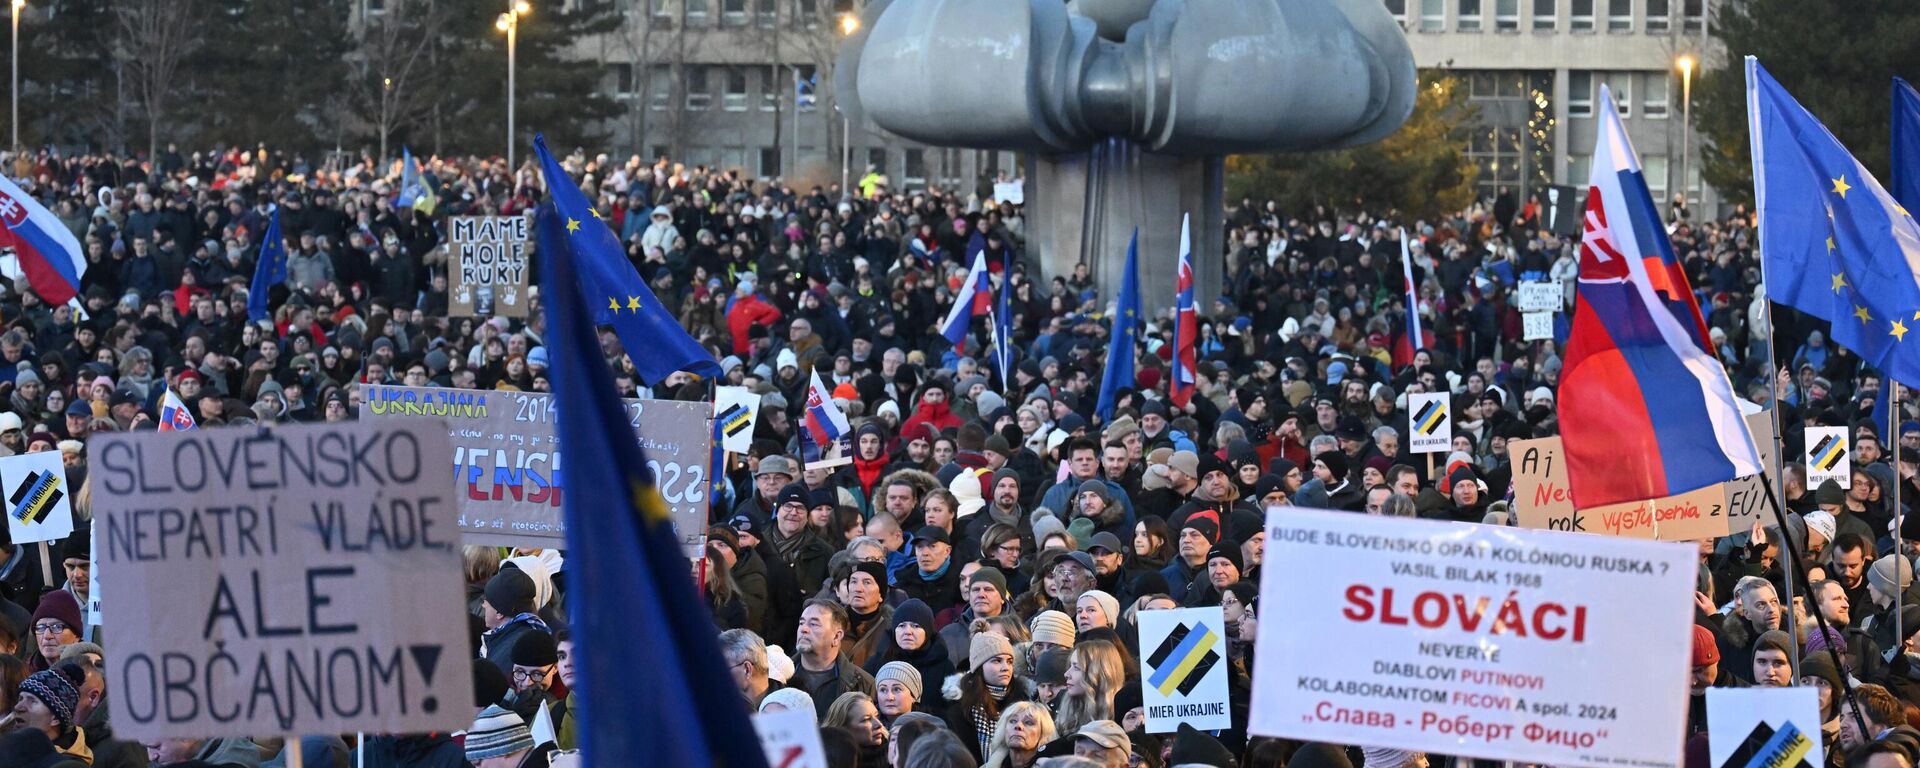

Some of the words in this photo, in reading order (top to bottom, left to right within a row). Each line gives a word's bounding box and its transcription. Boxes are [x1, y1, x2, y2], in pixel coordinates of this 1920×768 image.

[462, 264, 524, 285] RUKY
[368, 387, 488, 418] UKRAJINA
[17, 501, 34, 522] MIER
[32, 474, 57, 508] UKRAJINE
[107, 497, 277, 562] NEPATRÍ
[1549, 509, 1585, 532] rok
[1271, 526, 1319, 545] BUDE
[1325, 531, 1432, 555] SLOVENSKO
[1491, 545, 1586, 569] KOLÓNIOU
[1591, 555, 1654, 574] RUSKA
[1660, 562, 1670, 577] ?
[1391, 562, 1440, 580] VASIL
[1445, 566, 1498, 585] BILAK
[1505, 572, 1543, 588] 1968
[203, 565, 359, 640] ALE
[1342, 583, 1588, 644] SLOVÁCI
[123, 640, 444, 730] OBČANOM!
[1373, 660, 1456, 682] DIABLOVI
[1460, 668, 1544, 690] PUTINOVI
[1149, 705, 1175, 719] MIER
[1176, 702, 1225, 717] UKRAJINE
[1297, 675, 1448, 705] KOLABORANTOM
[1452, 691, 1510, 711] FICOVI
[1514, 698, 1527, 712] A
[1532, 702, 1573, 718] spol.
[1578, 703, 1618, 721] 2024
[1420, 711, 1515, 744] Роберт
